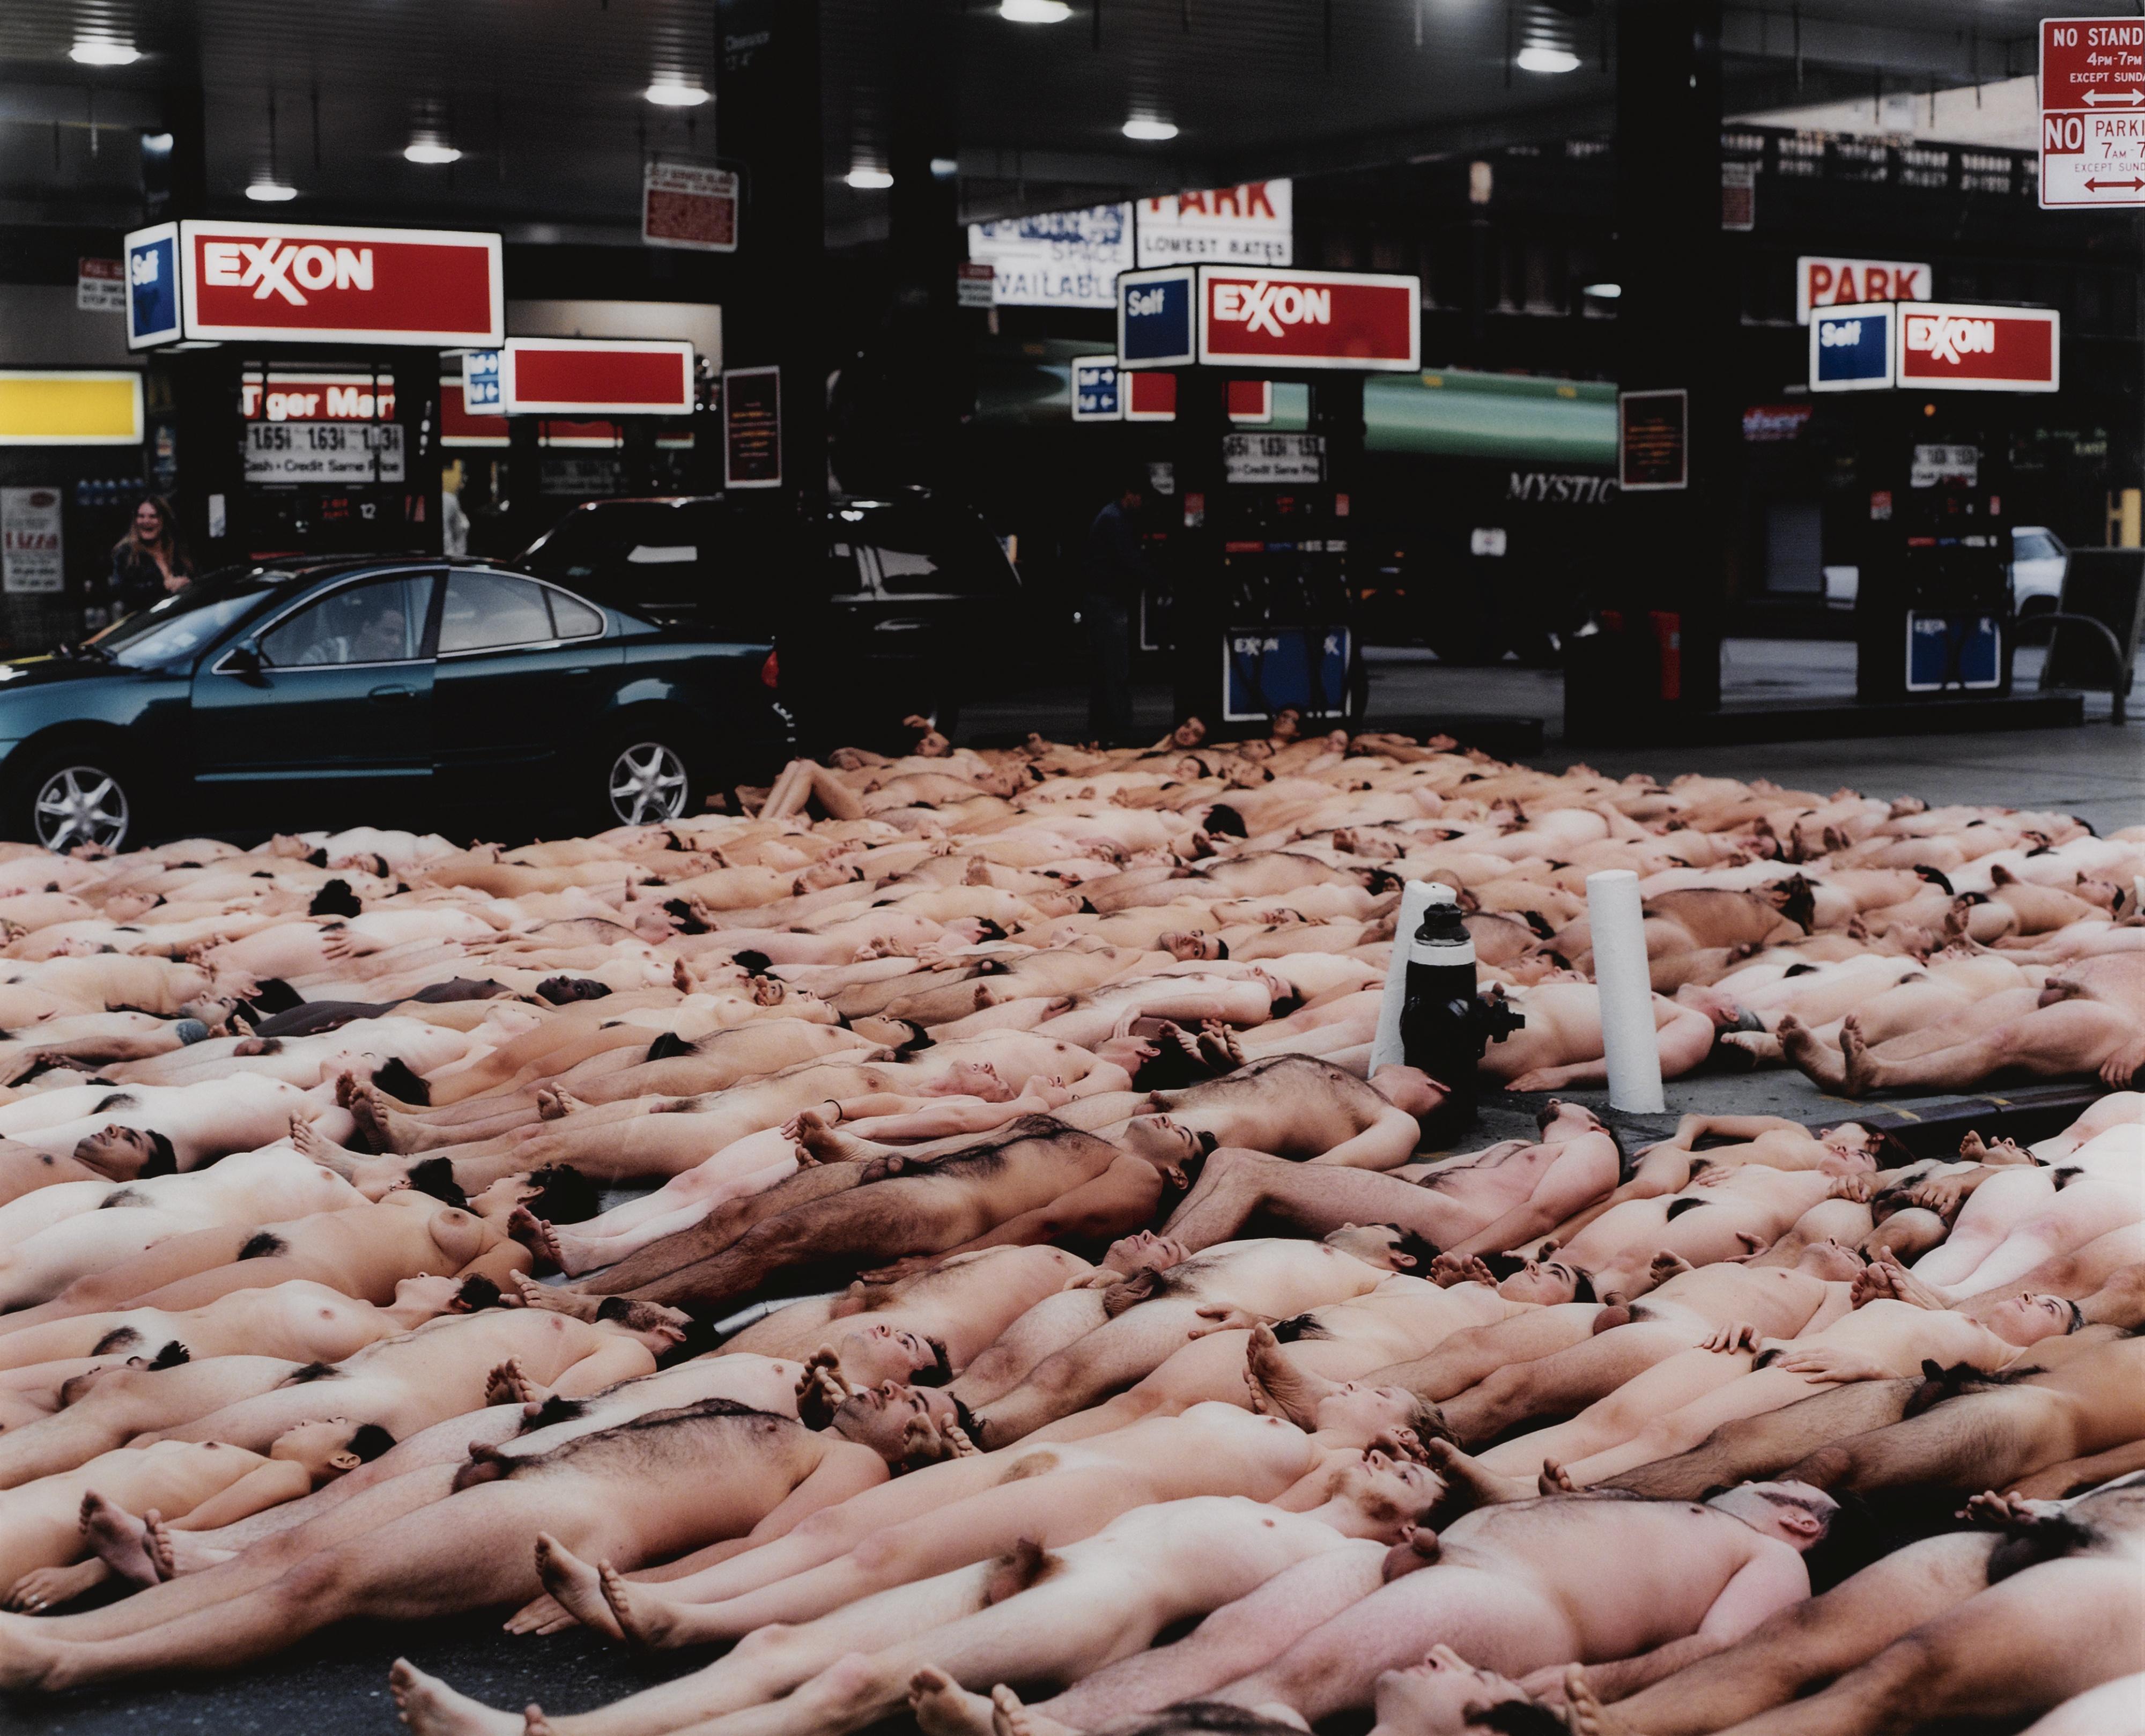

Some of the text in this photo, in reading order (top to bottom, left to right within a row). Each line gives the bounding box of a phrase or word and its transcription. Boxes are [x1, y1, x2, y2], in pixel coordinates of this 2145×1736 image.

[2053, 27, 2143, 47] NO STAND
[2070, 72, 2110, 83] EXCEPT
[2044, 117, 2083, 150] NO
[2074, 162, 2112, 172] EXCEPT
[1150, 181, 1276, 219] ARK
[1145, 237, 1283, 257] LOWEST RATES
[204, 237, 374, 306] EXXON
[994, 272, 1118, 298] VAILABL
[1809, 264, 1919, 307] PARK
[1128, 287, 1165, 316] Self
[1214, 274, 1331, 337] EXXON
[1907, 315, 1995, 365] EXXON
[242, 385, 321, 422] Tger
[1506, 472, 1620, 504] MYSTIC
